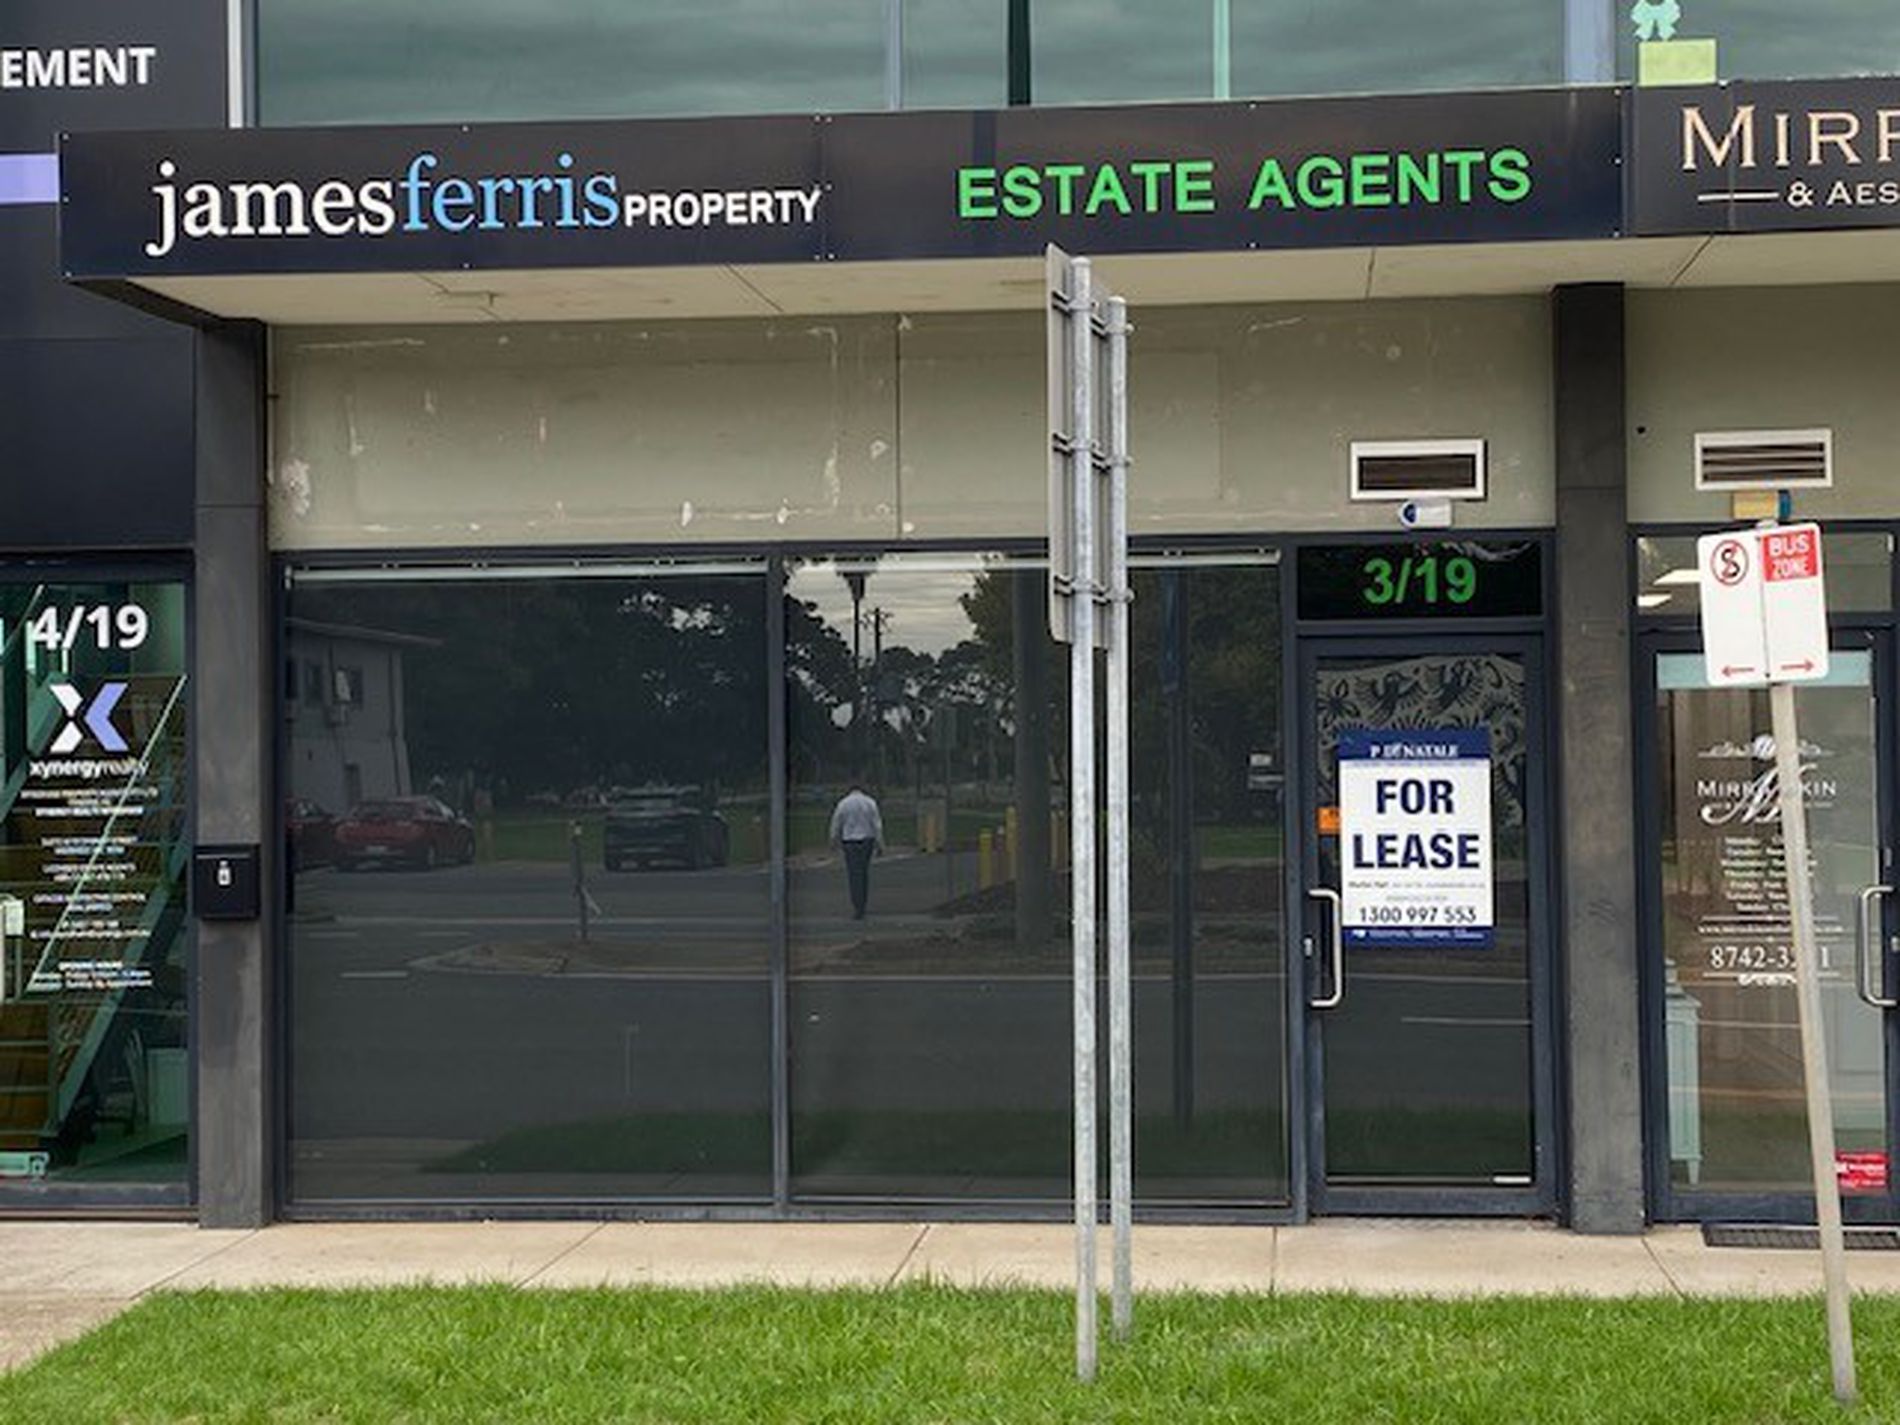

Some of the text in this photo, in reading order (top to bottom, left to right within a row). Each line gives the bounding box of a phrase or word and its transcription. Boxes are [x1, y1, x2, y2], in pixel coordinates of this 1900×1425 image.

[1, 47, 156, 88] EMENT
[957, 150, 1533, 219] ESTATE AGENTS
[1787, 180, 1900, 207] & AES
[1768, 533, 1811, 557] BUS
[1362, 557, 1478, 604] 3/19
[31, 604, 149, 651] 4/19
[1376, 779, 1455, 815] FOR
[1353, 833, 1481, 869] LEASE
[1360, 906, 1402, 922] 1300
[1406, 906, 1438, 922] 997
